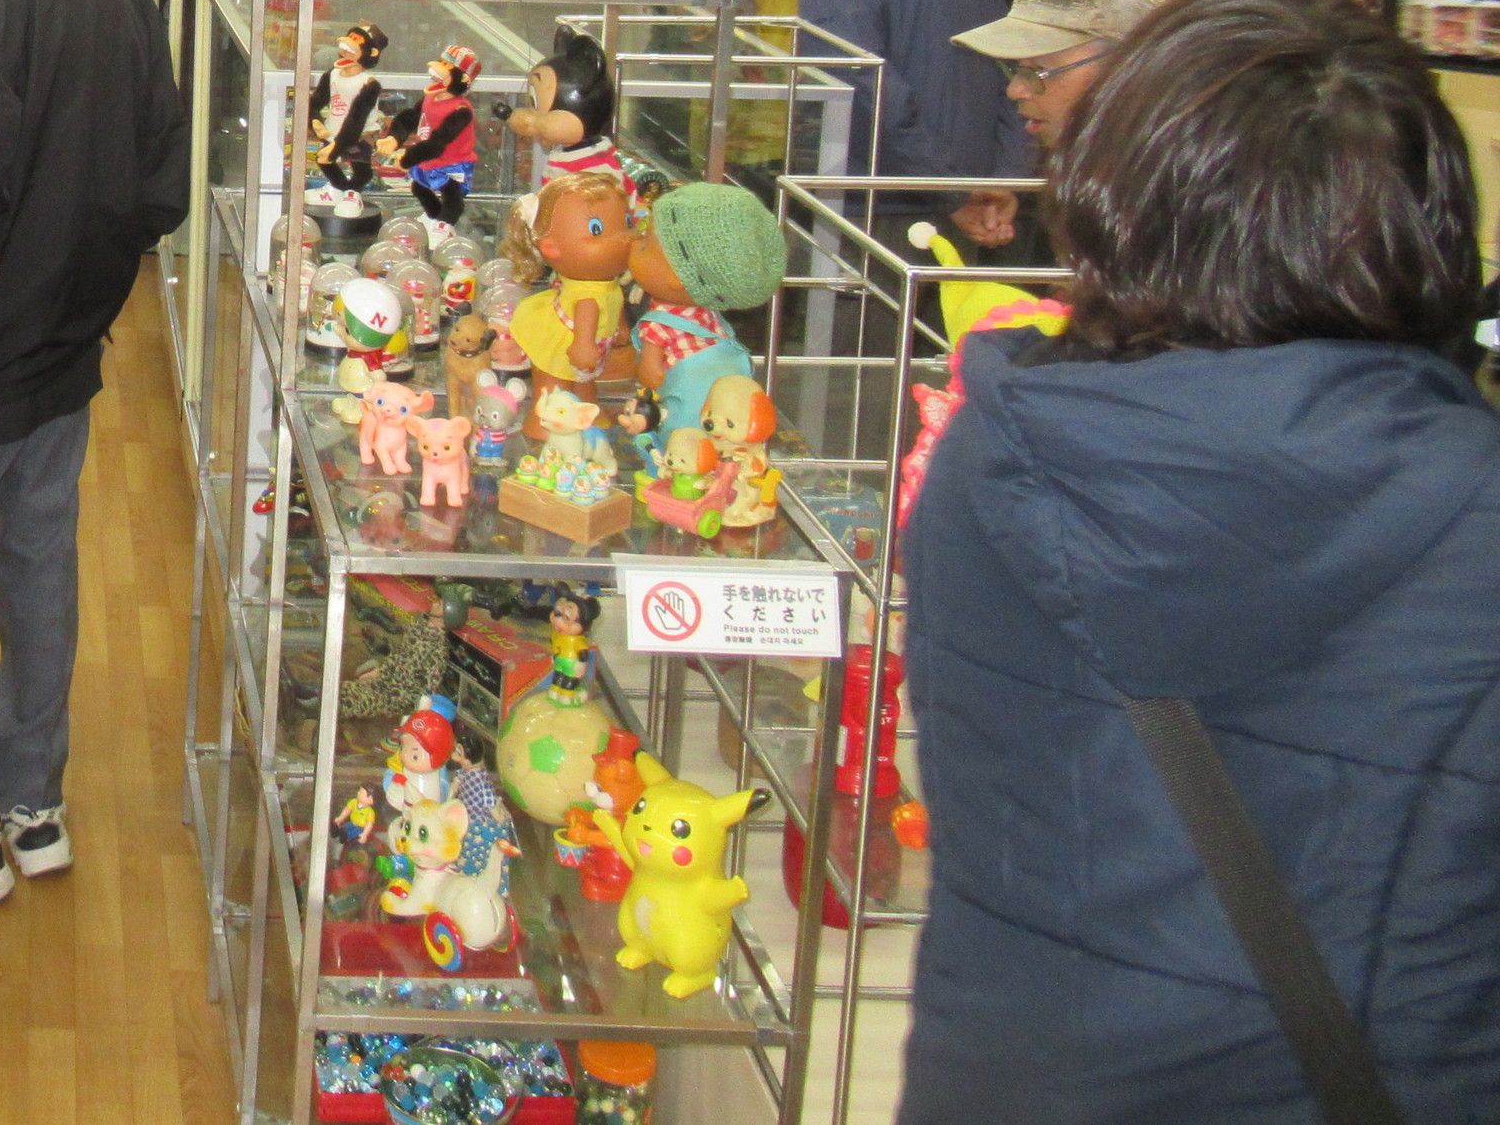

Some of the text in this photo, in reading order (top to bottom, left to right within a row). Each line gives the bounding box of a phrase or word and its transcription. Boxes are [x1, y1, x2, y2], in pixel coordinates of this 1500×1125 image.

[370, 311, 388, 328] N
[723, 584, 825, 604] 手を触れないで
[724, 604, 827, 623] ください
[724, 624, 755, 633] Please
[758, 625, 770, 634] do
[792, 627, 819, 635] touch
